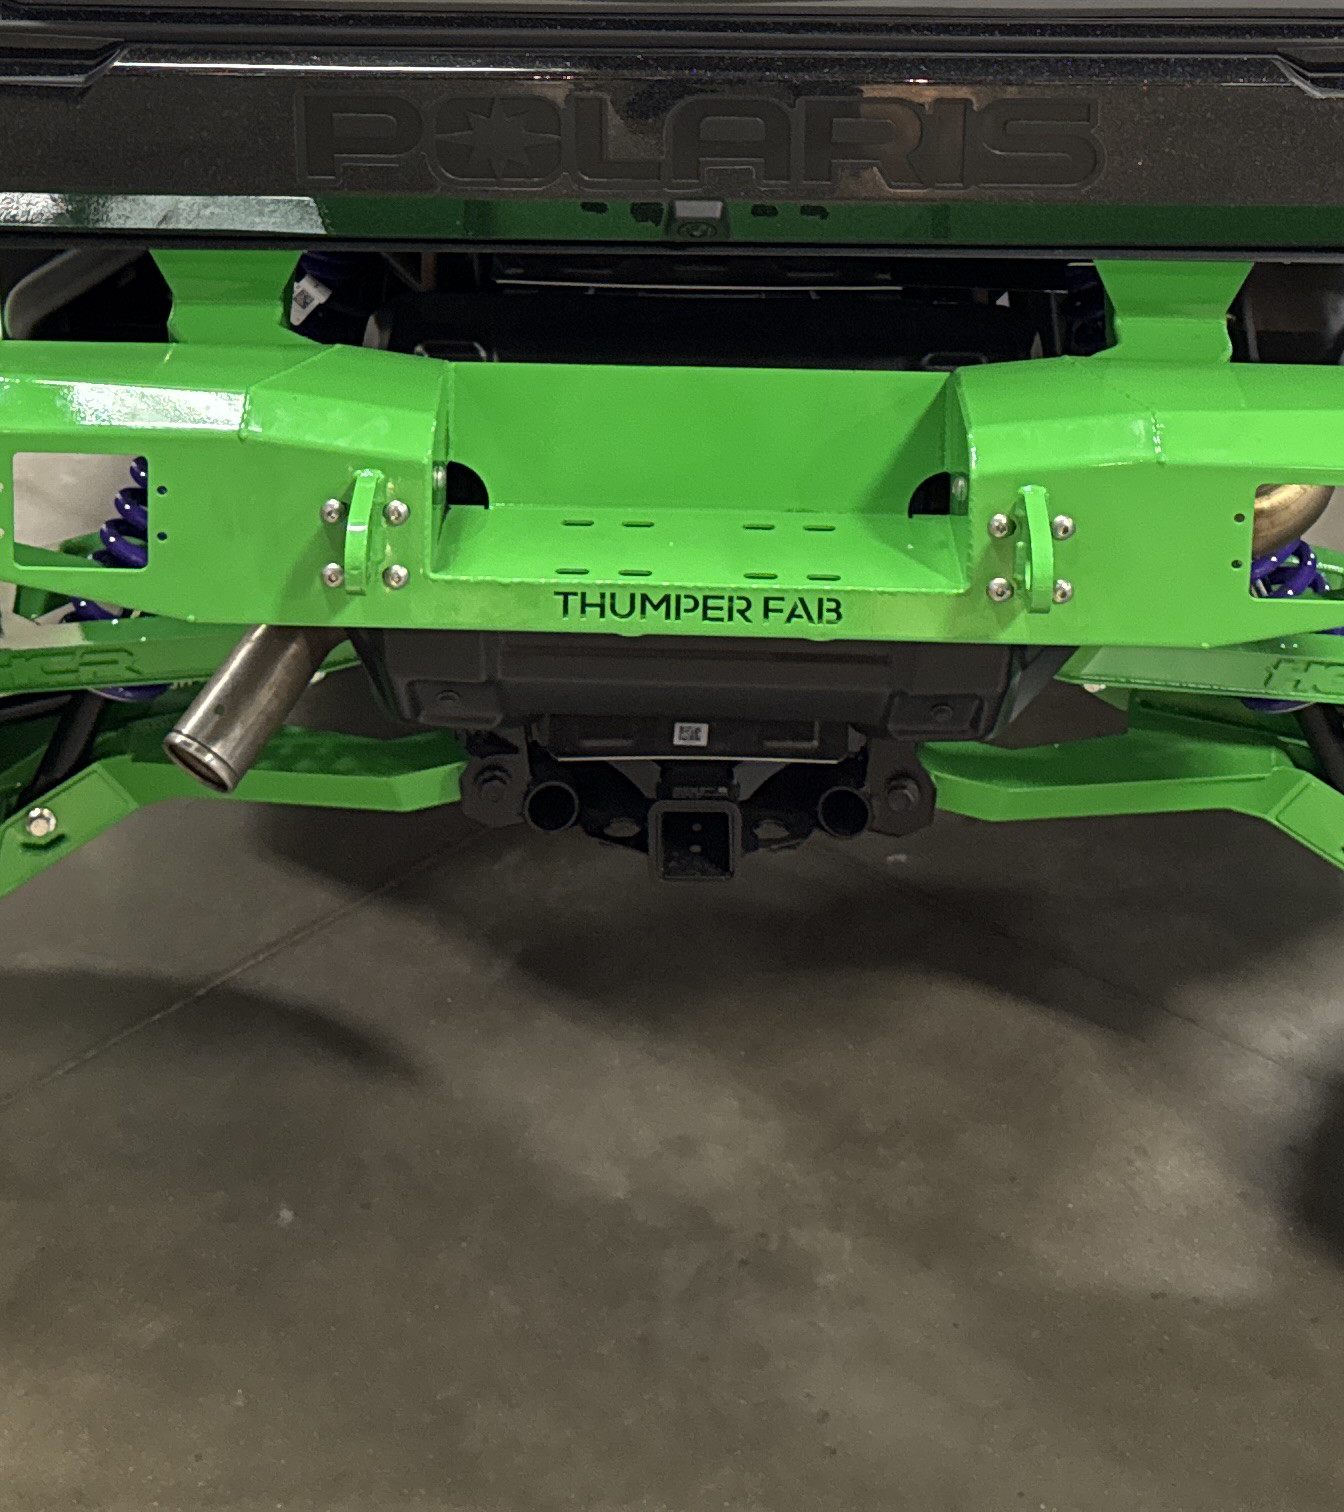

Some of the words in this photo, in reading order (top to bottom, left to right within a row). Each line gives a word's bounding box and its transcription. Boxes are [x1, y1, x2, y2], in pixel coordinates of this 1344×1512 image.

[296, 94, 1105, 190] POLARIS
[554, 590, 753, 624] THUMPER
[762, 595, 844, 625] FAB
